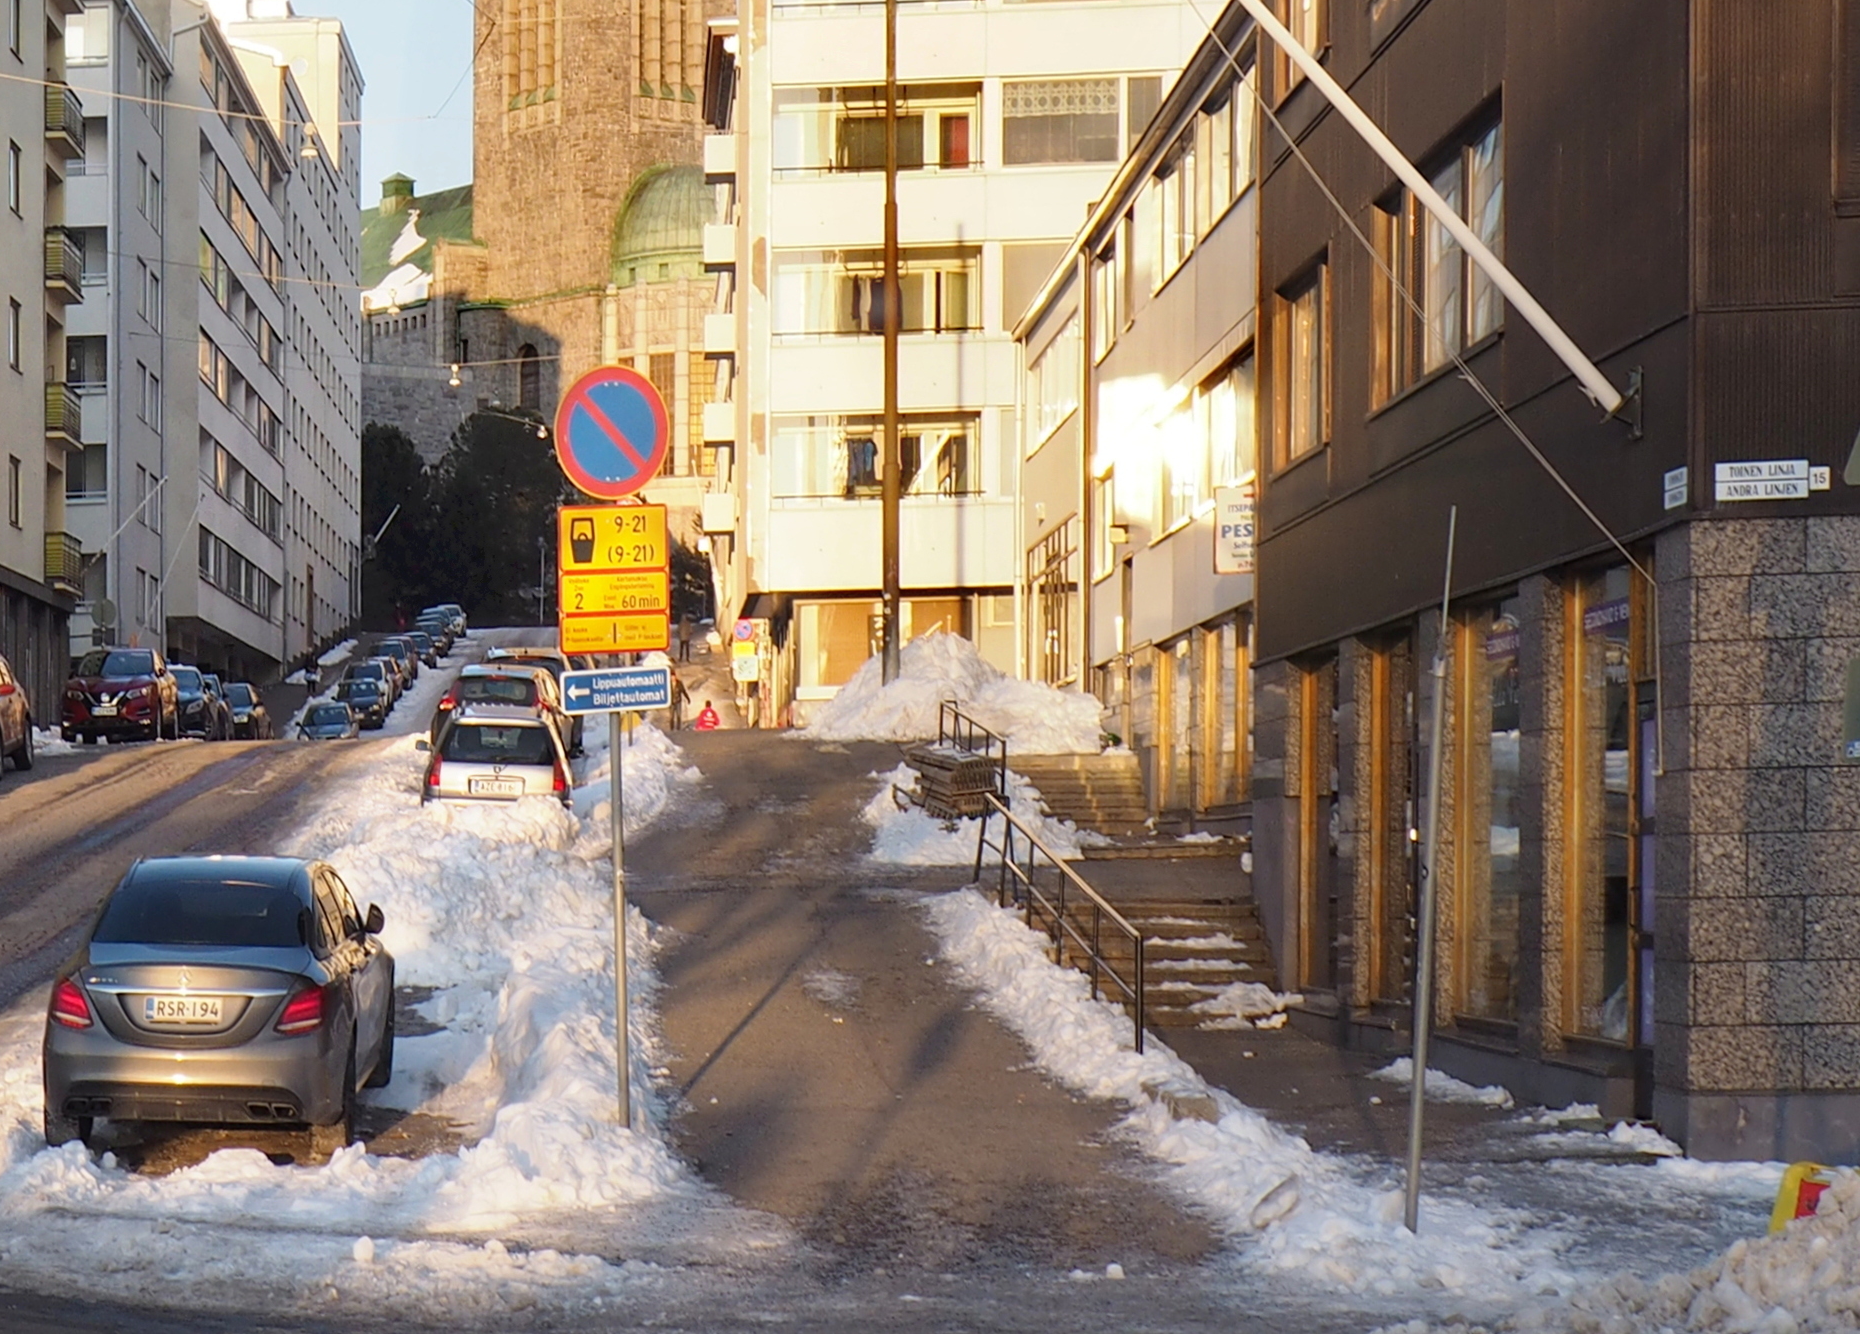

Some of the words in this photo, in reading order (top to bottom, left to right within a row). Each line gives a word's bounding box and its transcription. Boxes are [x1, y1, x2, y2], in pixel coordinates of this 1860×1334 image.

[1728, 465, 1762, 478] TOINEN
[1768, 463, 1796, 476] LINJA
[1813, 472, 1827, 484] 15
[1726, 484, 1759, 497] ANDRA
[1764, 483, 1798, 496] LINJEN
[615, 516, 646, 533] 9-21
[608, 544, 654, 563] (9-21)
[574, 592, 584, 610] 2
[621, 594, 637, 609] 60
[638, 594, 661, 608] min
[593, 674, 664, 690] Lippuautomaatti
[593, 689, 665, 705] Biljettautomat
